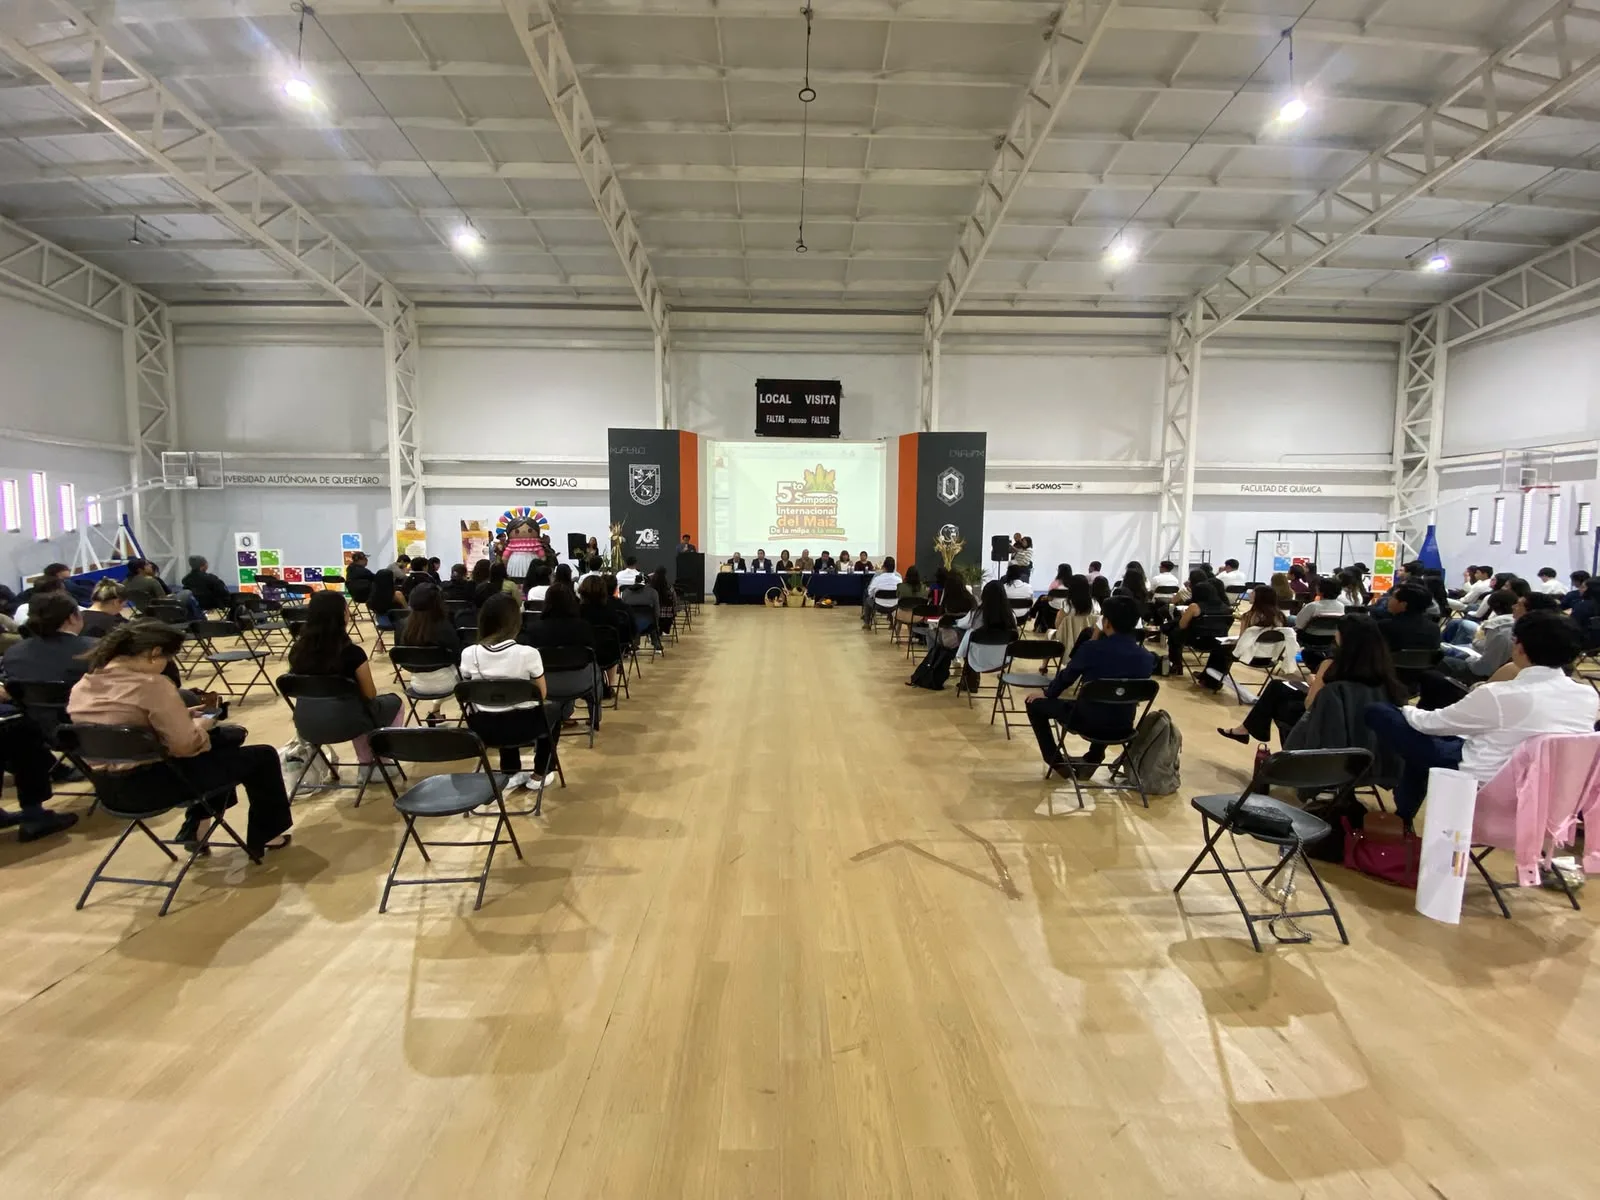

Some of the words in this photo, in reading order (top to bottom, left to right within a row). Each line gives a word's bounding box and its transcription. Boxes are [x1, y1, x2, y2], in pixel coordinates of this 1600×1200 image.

[760, 393, 792, 404] LOCAL
[805, 394, 836, 405] VISITA
[766, 414, 785, 423] FALTAS
[811, 415, 830, 424] FALTAS
[268, 473, 317, 484] AUTÓNOMA
[319, 476, 329, 484] DE
[331, 474, 380, 485] QUERÉTARO
[515, 477, 578, 487] SOMOSUAQ
[1240, 484, 1277, 493] FACULTAD
[794, 491, 838, 506] Simposio
[777, 506, 836, 515] Internacional
[777, 515, 799, 527] del
